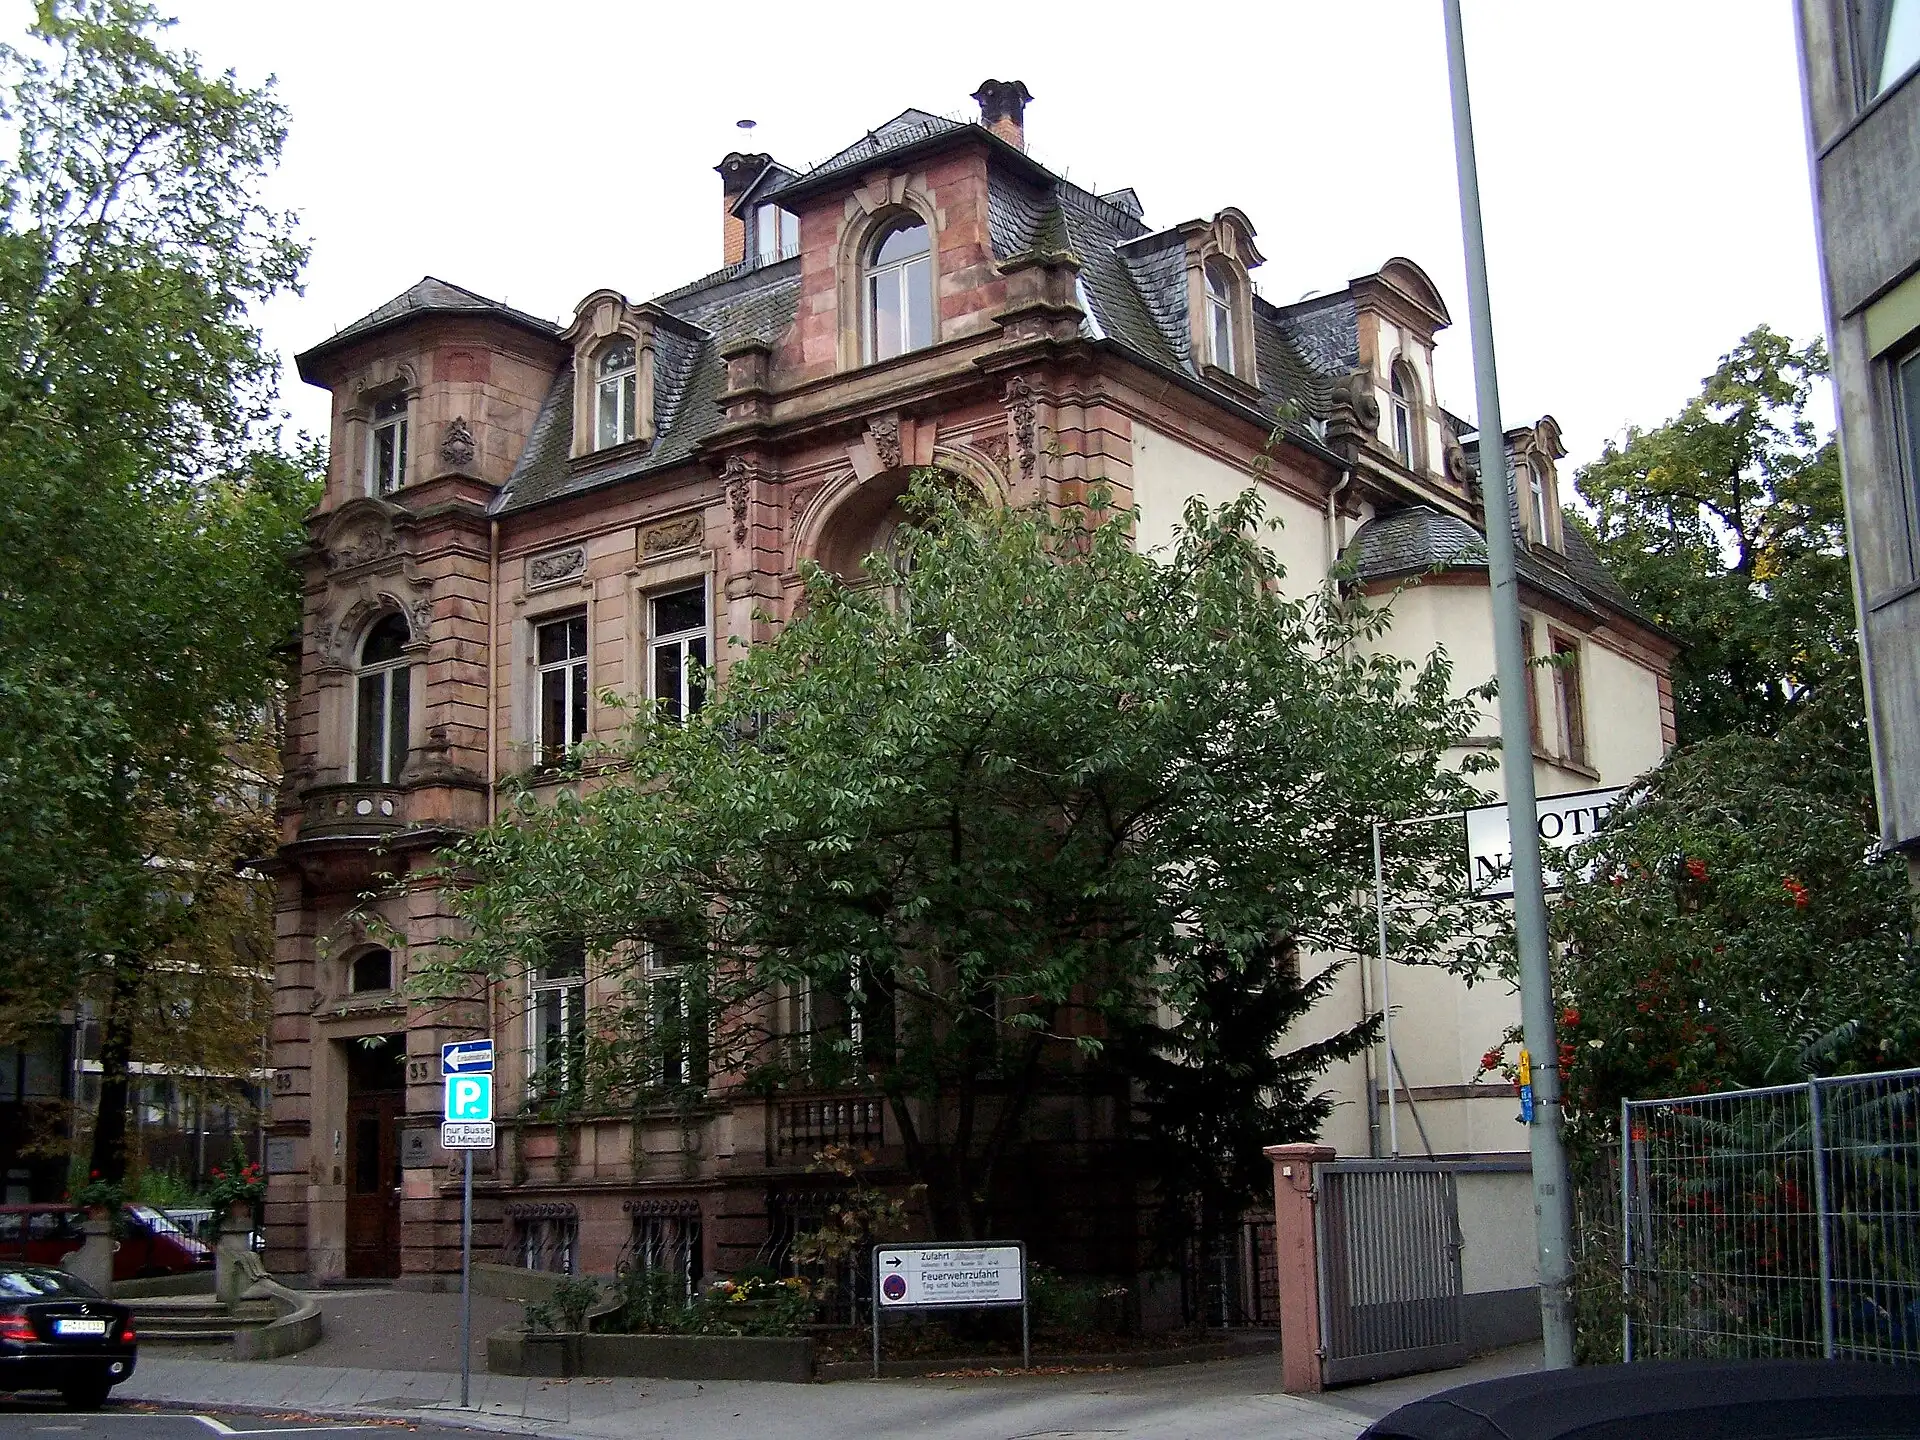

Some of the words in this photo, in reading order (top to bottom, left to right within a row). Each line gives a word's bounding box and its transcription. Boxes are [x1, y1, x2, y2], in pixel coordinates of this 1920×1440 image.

[456, 1080, 481, 1115] P
[464, 1126, 490, 1134] Busse
[446, 1135, 456, 1143] 30
[458, 1135, 491, 1143] Minuten
[921, 1252, 950, 1261] Zufahrt
[921, 1269, 999, 1281] Feuerwehrzufahrt
[922, 1282, 934, 1290] Tag
